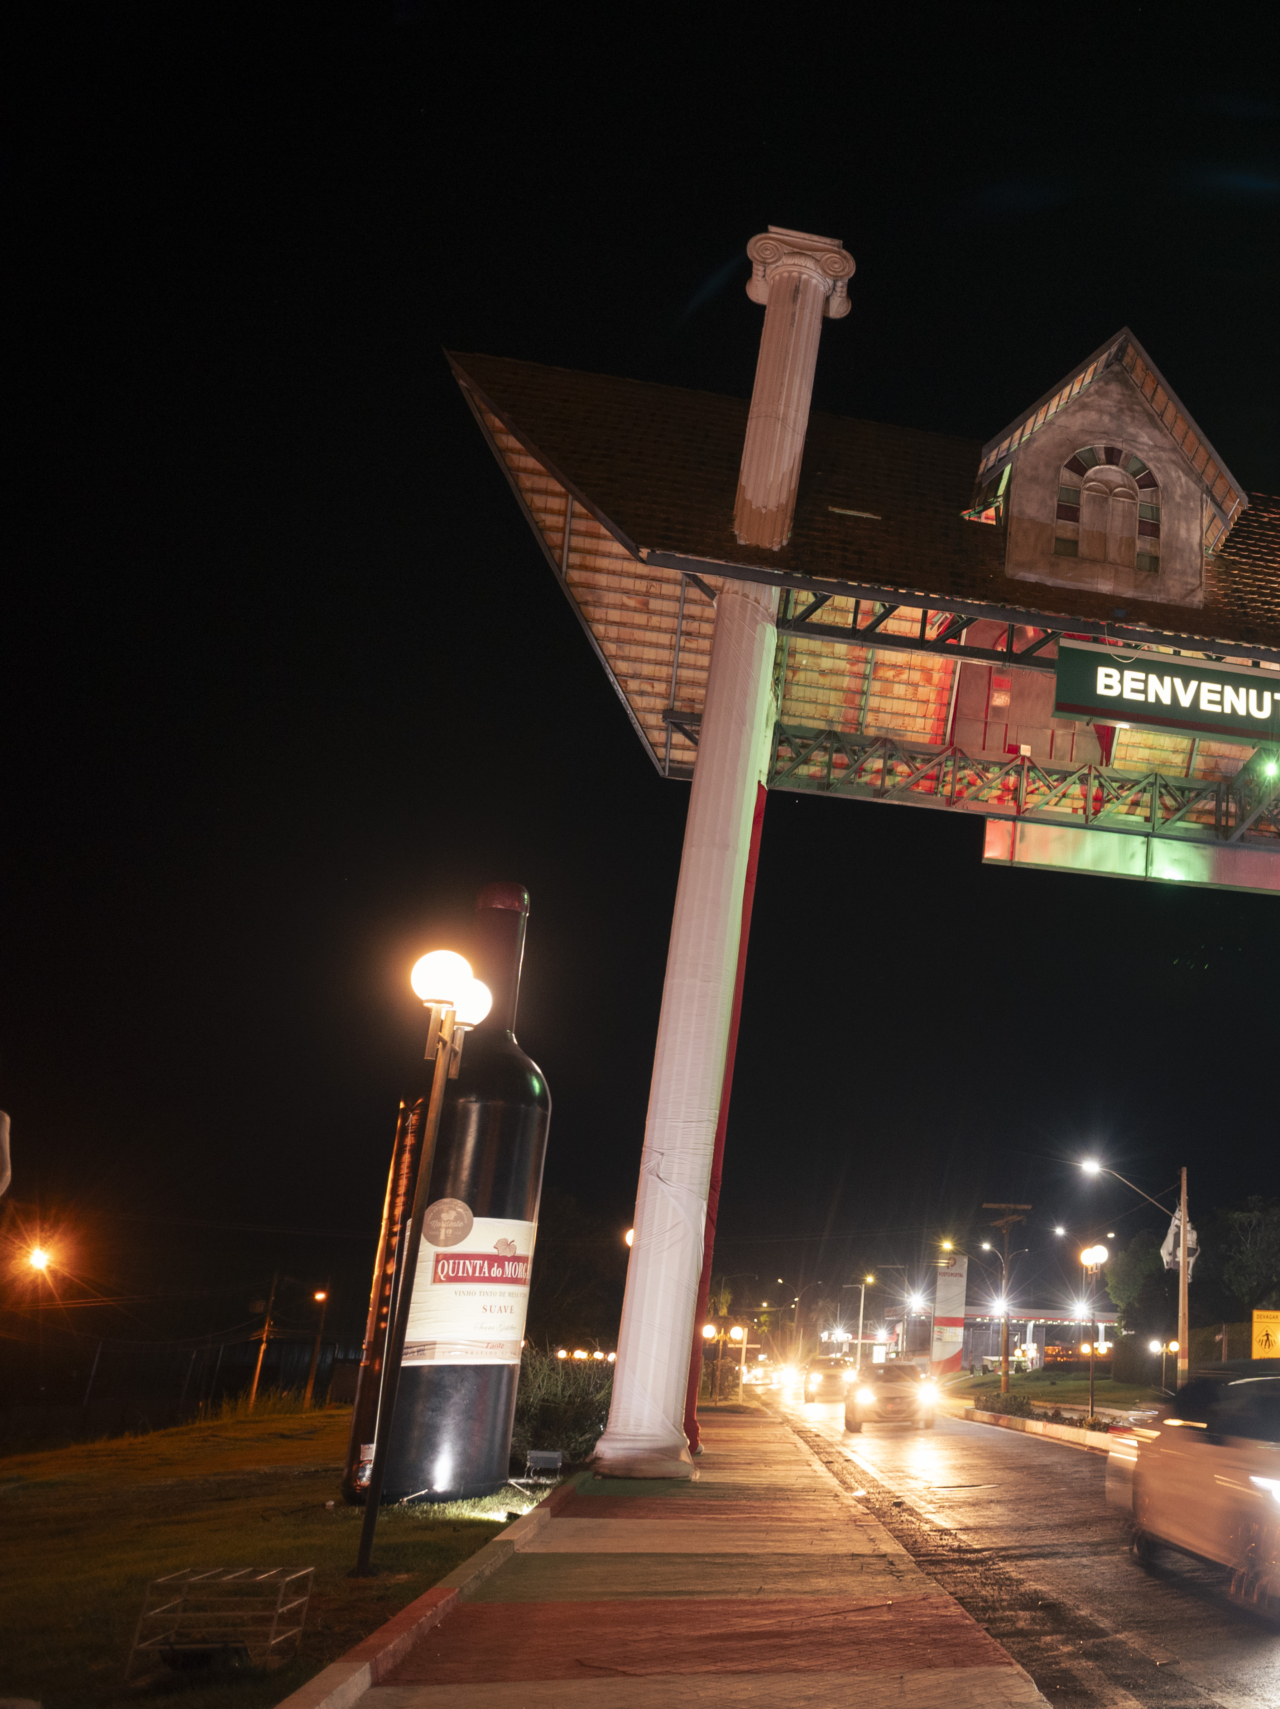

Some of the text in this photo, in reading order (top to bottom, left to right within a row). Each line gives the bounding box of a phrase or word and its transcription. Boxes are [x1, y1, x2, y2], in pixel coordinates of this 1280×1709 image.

[437, 1259, 489, 1281] QUINTA
[490, 1262, 502, 1278] do
[478, 1290, 498, 1298] TINTO
[481, 1304, 515, 1314] SUAVE
